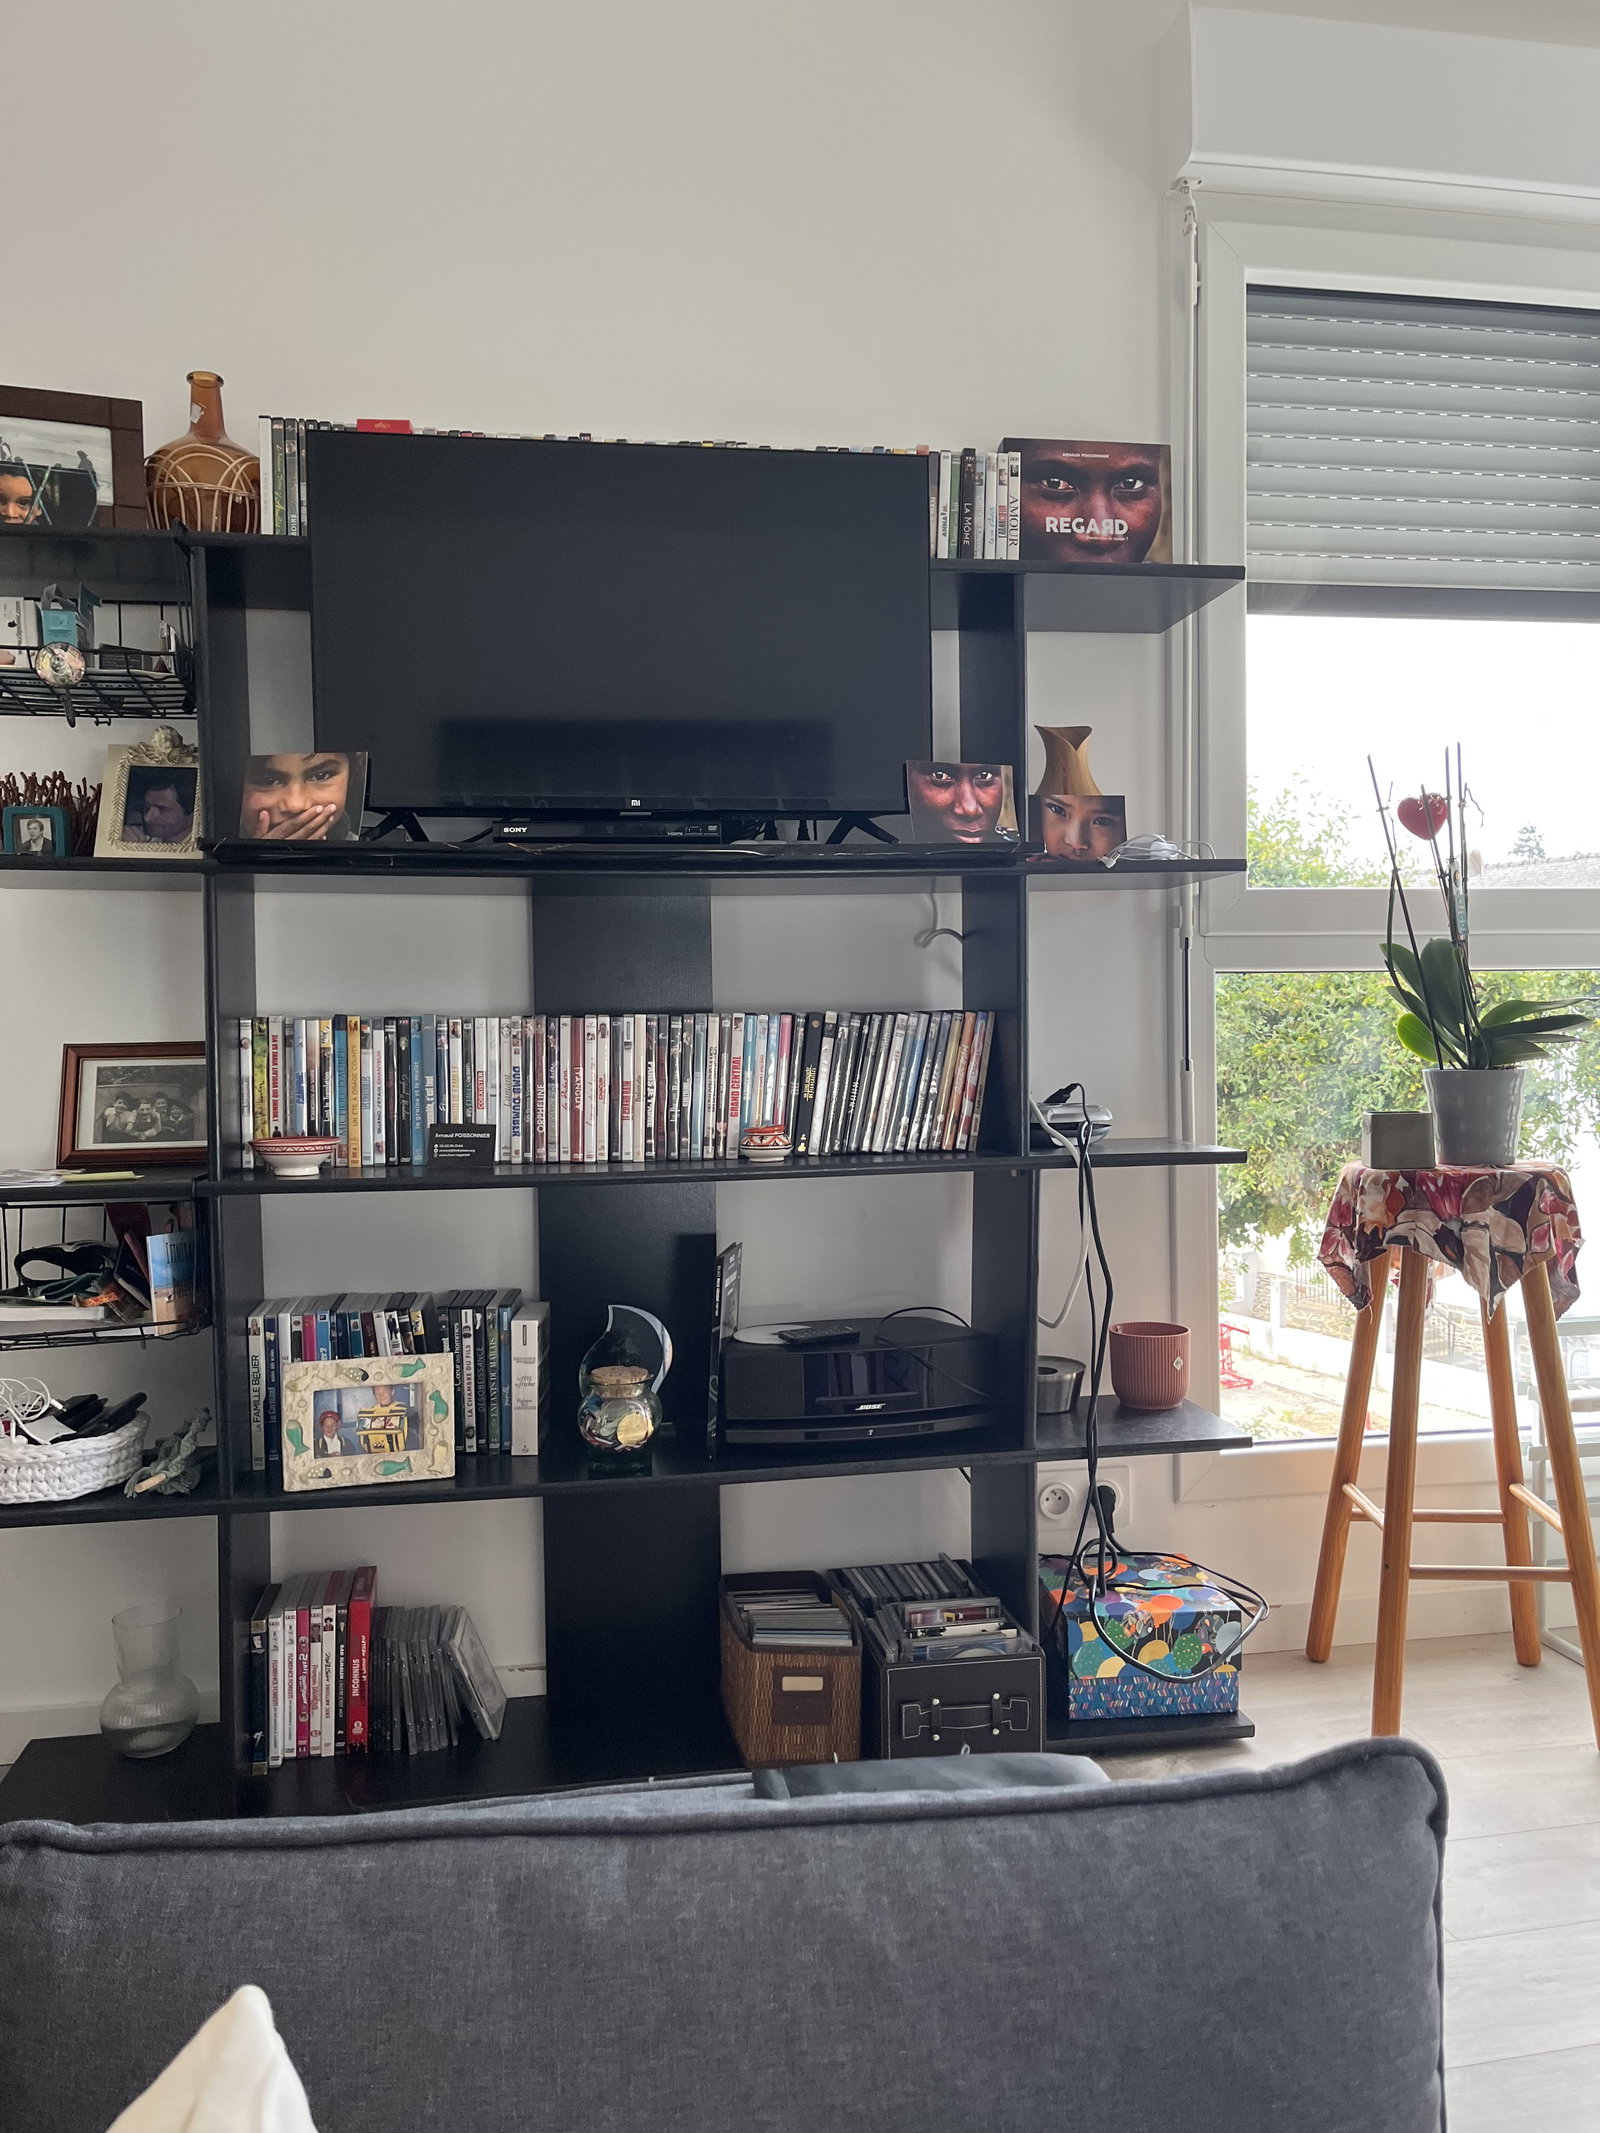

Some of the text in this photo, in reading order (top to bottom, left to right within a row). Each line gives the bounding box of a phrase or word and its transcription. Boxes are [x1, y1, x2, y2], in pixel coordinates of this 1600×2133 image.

[963, 503, 972, 545] LA MÔME
[1009, 495, 1019, 547] AMOUR
[1045, 517, 1129, 536] REGARD
[271, 1052, 279, 1066] VIVRE
[271, 1068, 279, 1088] VOULAIT
[337, 1047, 347, 1136] MICHOU D'AUBER
[575, 1070, 583, 1111] TANGUY
[730, 1056, 741, 1118] GRAND CENTRAL
[271, 1089, 279, 1099] QUI
[512, 1066, 521, 1137] DUMB DUMBER
[647, 1087, 654, 1097] JE
[271, 1100, 279, 1122] L'HOMME
[352, 1117, 358, 1127] UN
[414, 1098, 422, 1121] graine
[537, 1084, 545, 1133] ORPHELINE
[251, 1354, 261, 1386] BÉLIER
[466, 1360, 472, 1371] DU
[490, 1371, 497, 1380] DU
[252, 1387, 261, 1423] FAMILLE
[490, 1381, 498, 1417] ENFANTS
[467, 1408, 473, 1418] LA
[352, 1658, 360, 1696] INCONNUS
